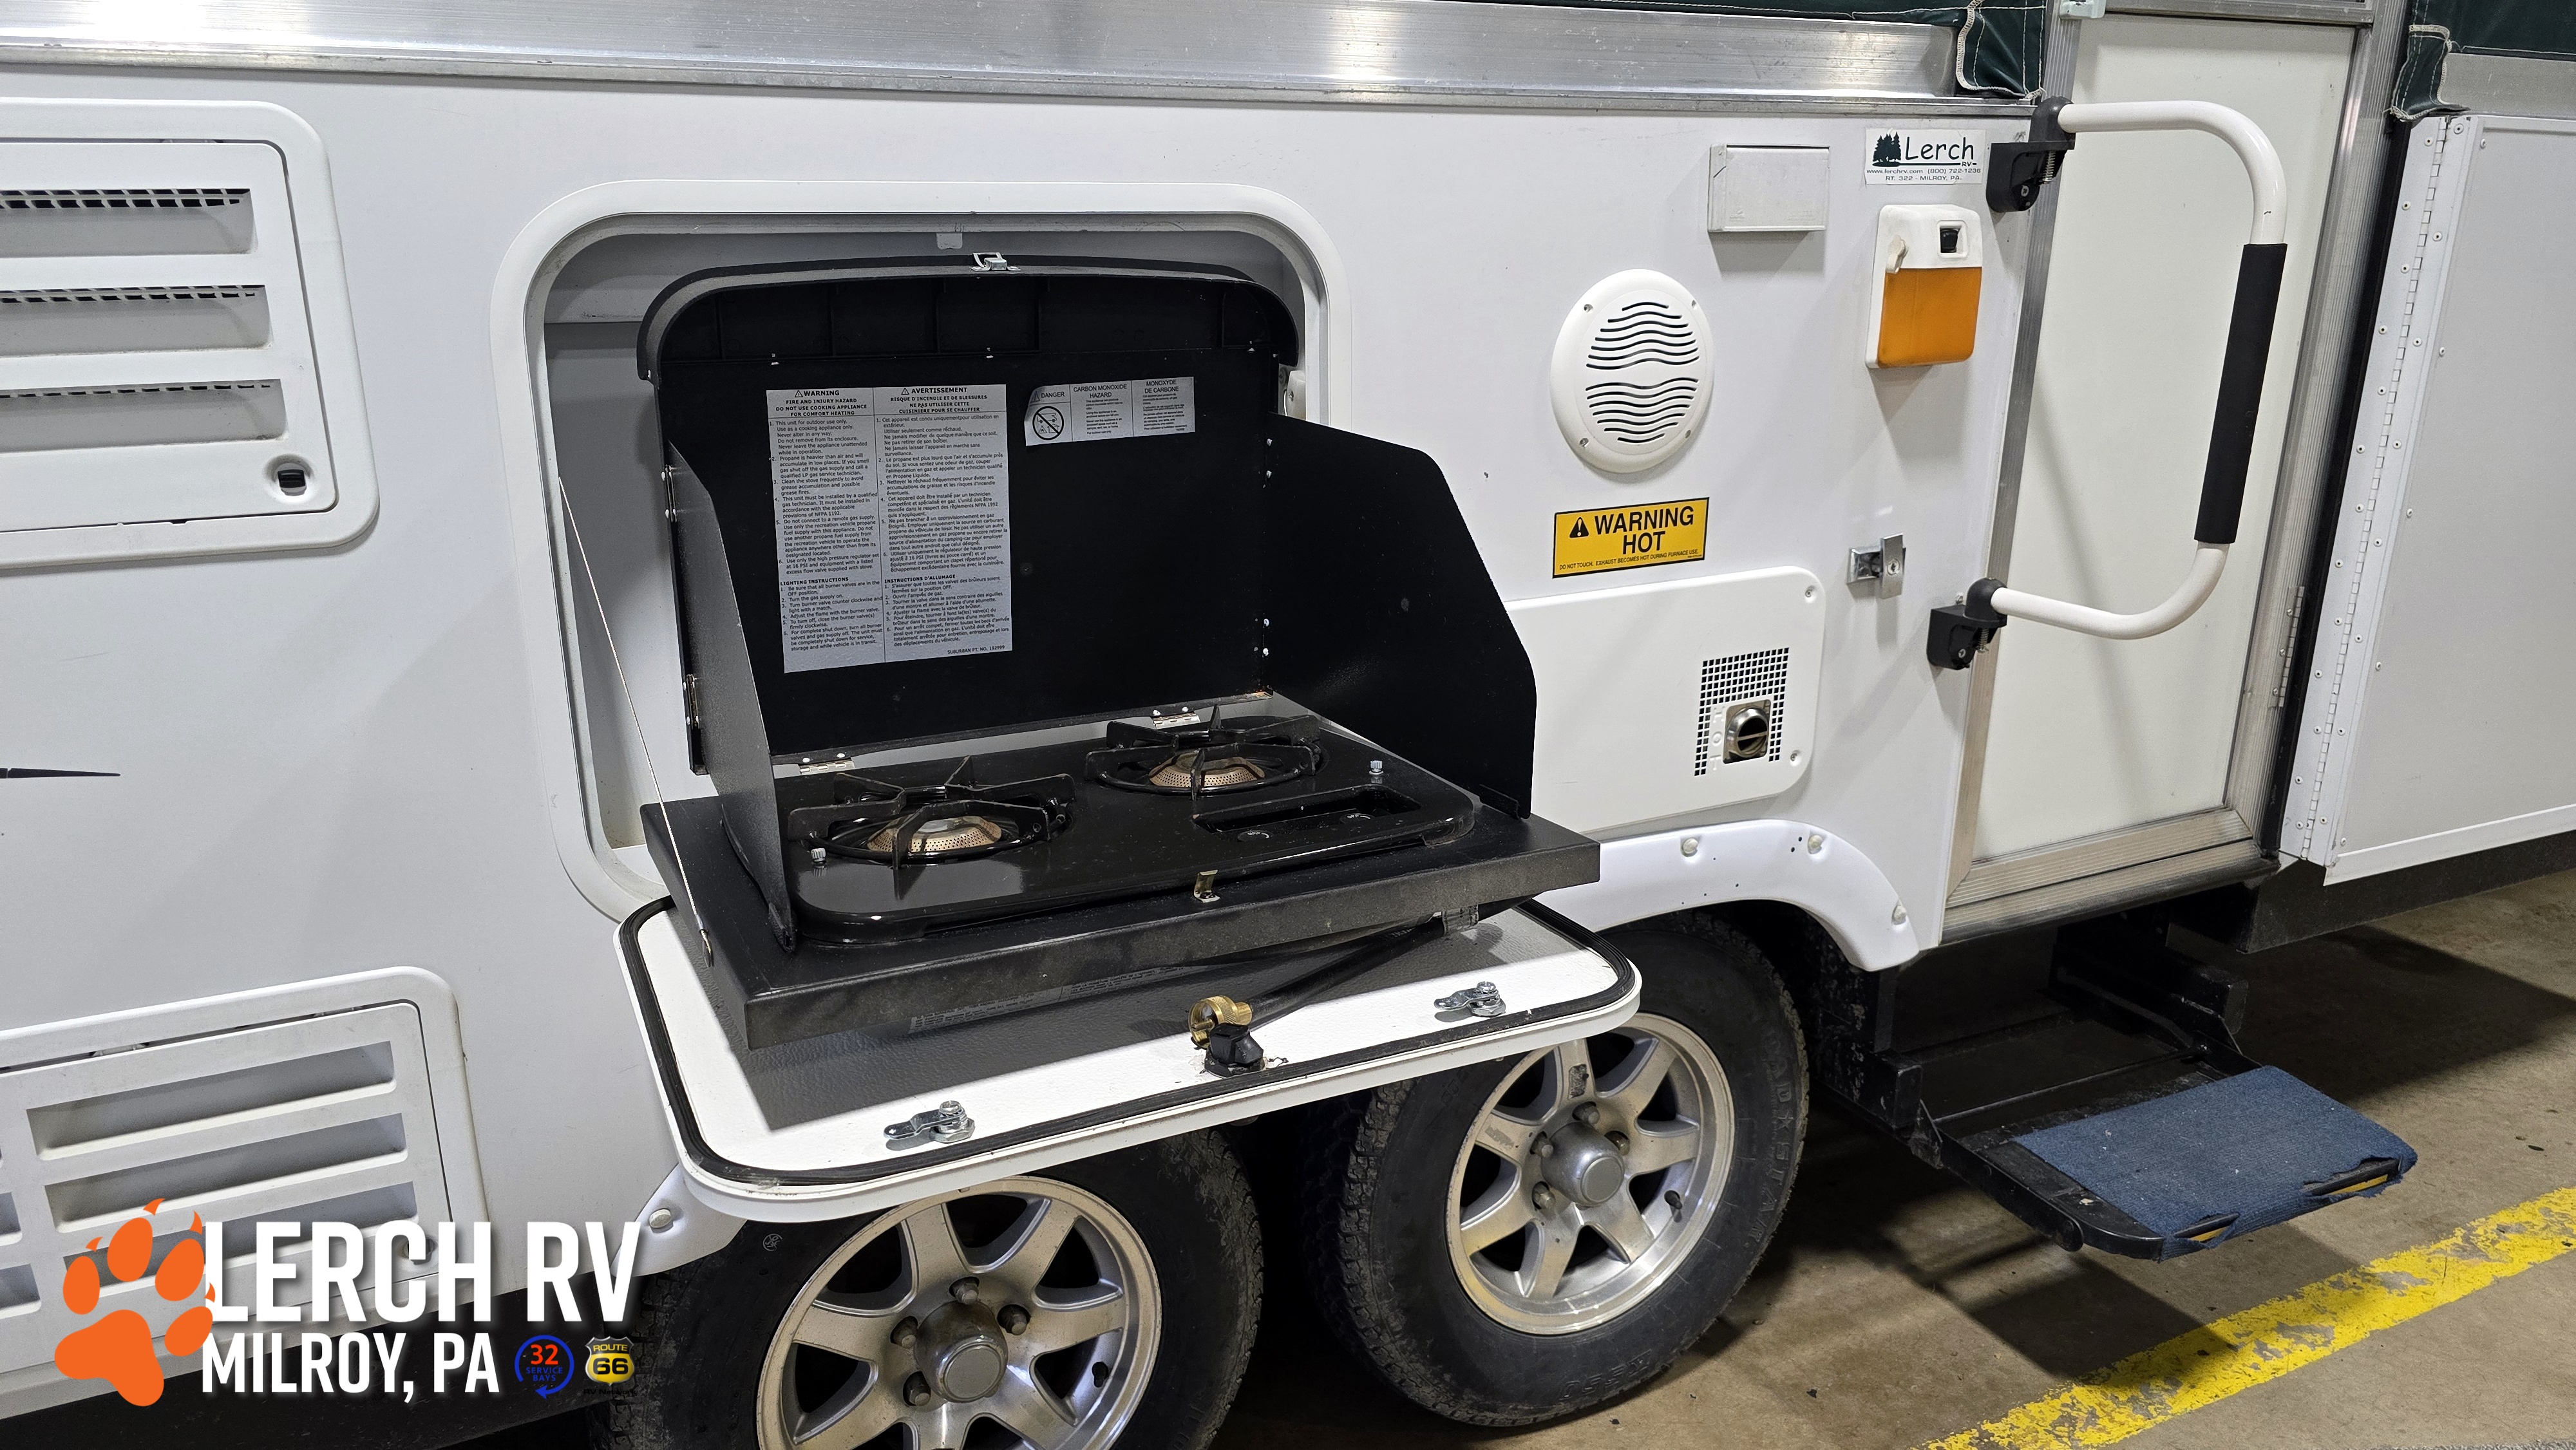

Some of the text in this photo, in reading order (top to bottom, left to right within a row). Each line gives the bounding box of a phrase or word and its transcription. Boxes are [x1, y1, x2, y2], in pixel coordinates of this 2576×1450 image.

[1906, 137, 1974, 160] Lerch
[1594, 505, 1694, 535] WARNING
[1622, 531, 1666, 555] HOT
[1617, 556, 1640, 564] BECOMES
